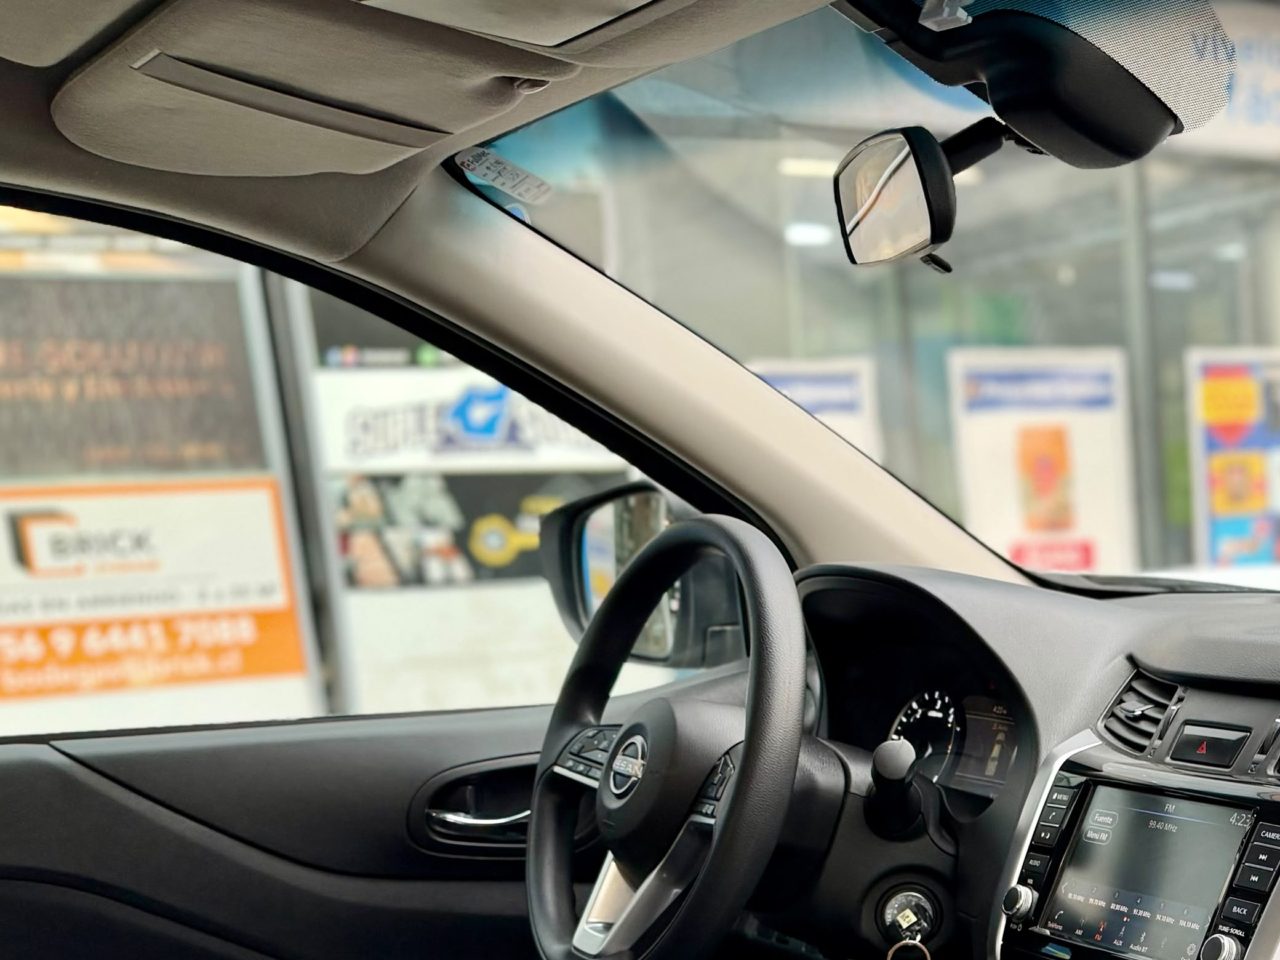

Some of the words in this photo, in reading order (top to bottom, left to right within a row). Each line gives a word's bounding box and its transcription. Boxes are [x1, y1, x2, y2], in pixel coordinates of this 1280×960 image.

[50, 530, 155, 560] BRICK
[1164, 803, 1175, 813] FM
[1094, 814, 1113, 825] Fuente
[1232, 905, 1247, 916] BACK
